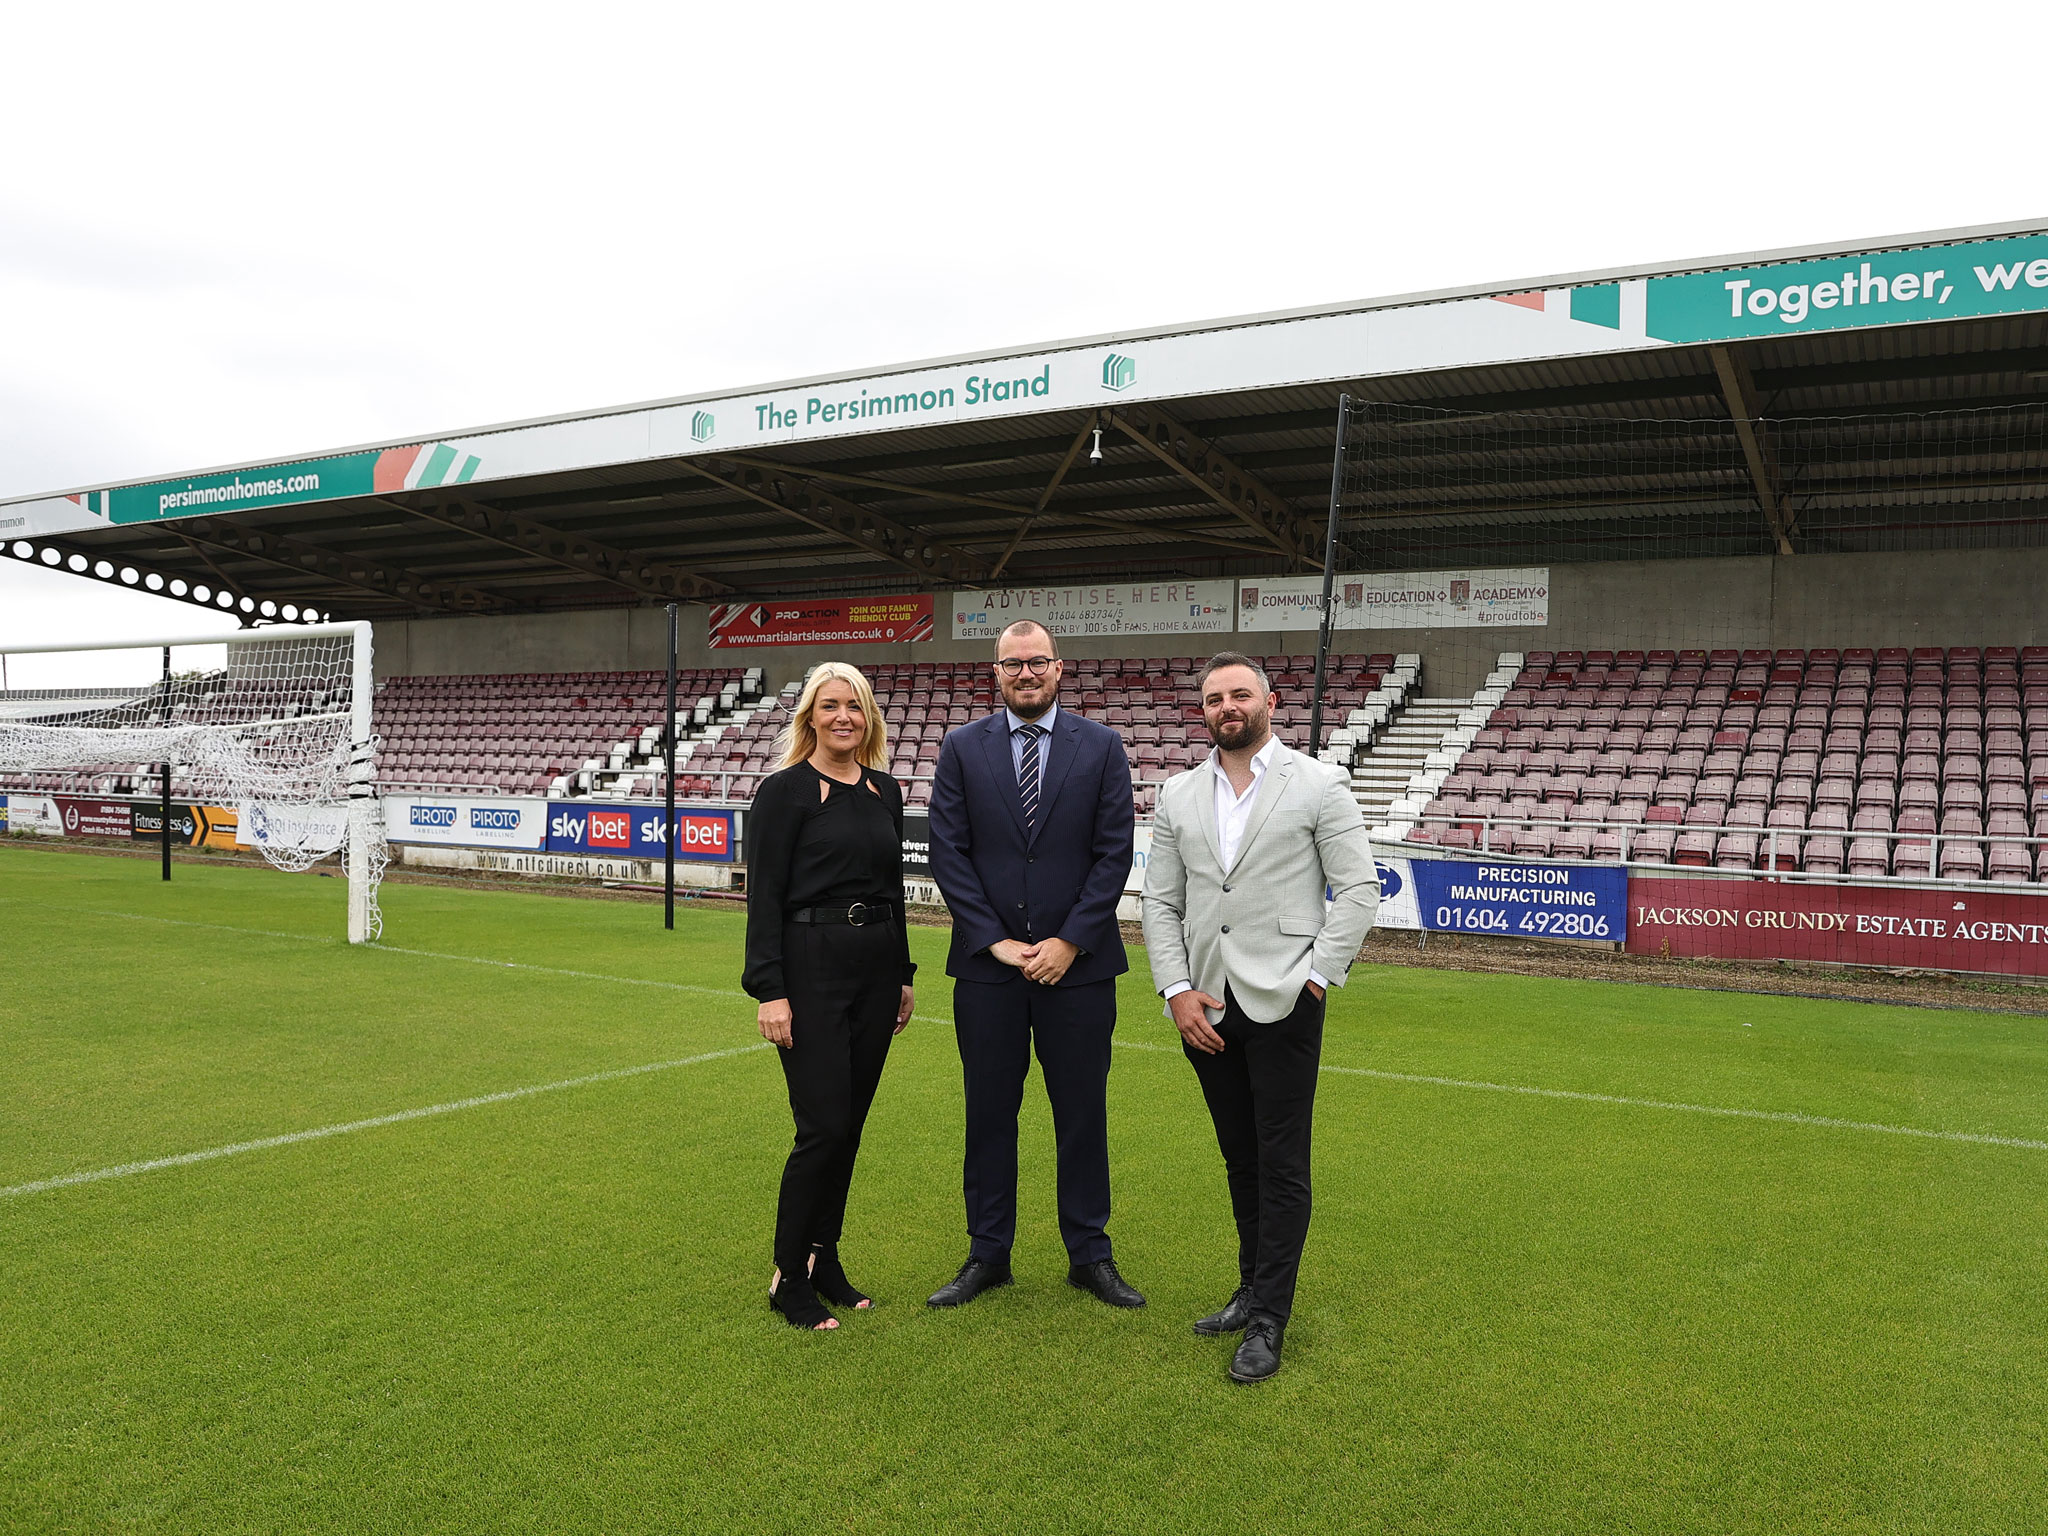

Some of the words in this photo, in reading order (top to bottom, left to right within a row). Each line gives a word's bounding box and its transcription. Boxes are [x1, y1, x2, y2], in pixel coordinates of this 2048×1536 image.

[1725, 262, 1954, 324] Together,
[755, 402, 797, 431] The
[806, 388, 954, 425] Persimmon
[964, 364, 1050, 405] Stand
[159, 473, 319, 515] persimmonhomes.com
[984, 588, 1115, 609] ADVERTISE
[1132, 585, 1195, 603] HERE
[1262, 594, 1323, 607] COMMUNIT
[1367, 591, 1435, 603] EDUCATION
[1473, 587, 1536, 600] ACADEMY
[849, 606, 868, 614] JOIN
[870, 605, 887, 613] OUR
[889, 603, 918, 612] FAMILY
[1048, 610, 1076, 621] 01604
[1079, 608, 1124, 620] 683734/5
[849, 614, 886, 623] FRIENDLY
[889, 613, 911, 621] CLUB
[1069, 624, 1080, 633] BY
[1110, 623, 1122, 632] OF
[1124, 622, 1150, 633] FANS,
[1153, 622, 1179, 631] HOME
[1182, 621, 1189, 630] &
[1191, 620, 1220, 630] AWAY!
[728, 627, 882, 644] www.martialartslessons.co.uk
[962, 627, 977, 636] GET
[979, 627, 1000, 636] YOUR
[411, 809, 456, 824] PIROTO
[472, 811, 520, 828] PIROTO
[552, 812, 585, 844] sky
[592, 815, 626, 840] bet
[641, 816, 679, 843] sk
[685, 819, 723, 846] bet
[477, 854, 638, 880] www.ntfcdirect.co.uk
[1478, 866, 1569, 885] PRECISION
[1451, 885, 1596, 907] MANUFACTURING
[1436, 906, 1509, 931] 01604
[1519, 911, 1610, 937] 492806
[1636, 907, 1740, 928] JACKSON
[1745, 910, 1850, 932] GRUNDY
[1856, 914, 1947, 938] ESTATE
